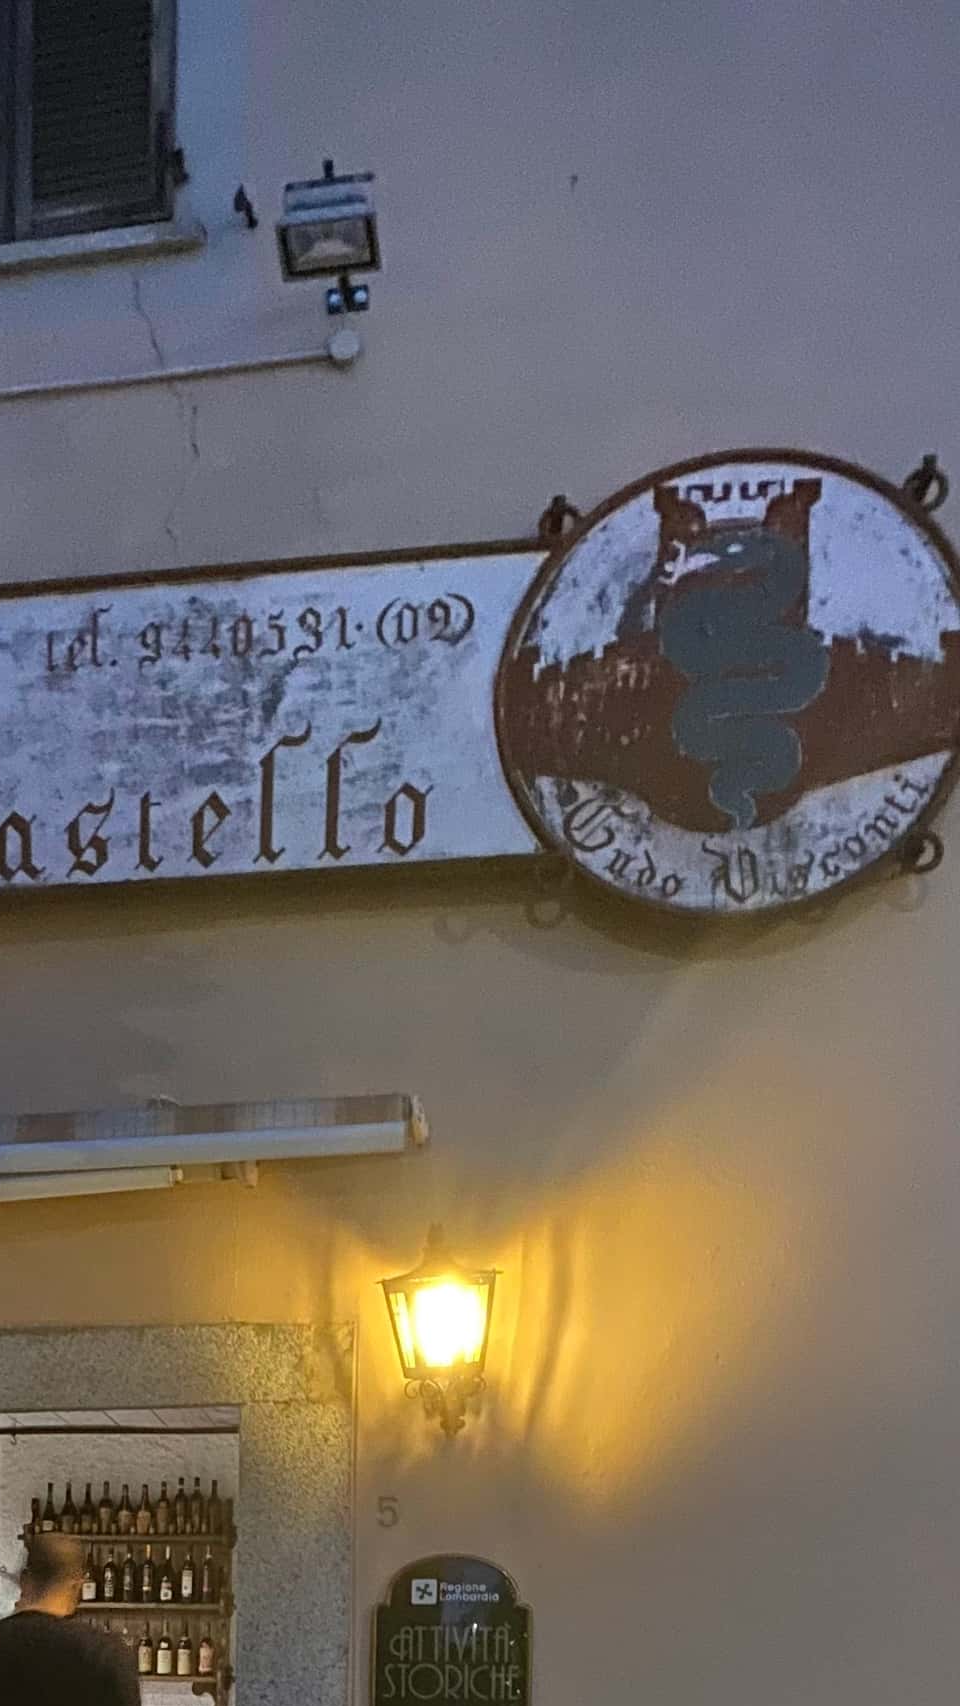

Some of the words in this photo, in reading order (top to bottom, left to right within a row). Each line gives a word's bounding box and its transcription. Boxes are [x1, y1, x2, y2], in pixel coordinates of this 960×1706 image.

[563, 797, 687, 897] Gudo
[700, 772, 930, 905] Visconti
[376, 1495, 400, 1528] 5
[439, 1581, 487, 1593] Regione
[439, 1590, 500, 1602] Lombardia
[390, 1621, 512, 1663] ATTIVITÀ
[383, 1662, 522, 1700] STORICHE
